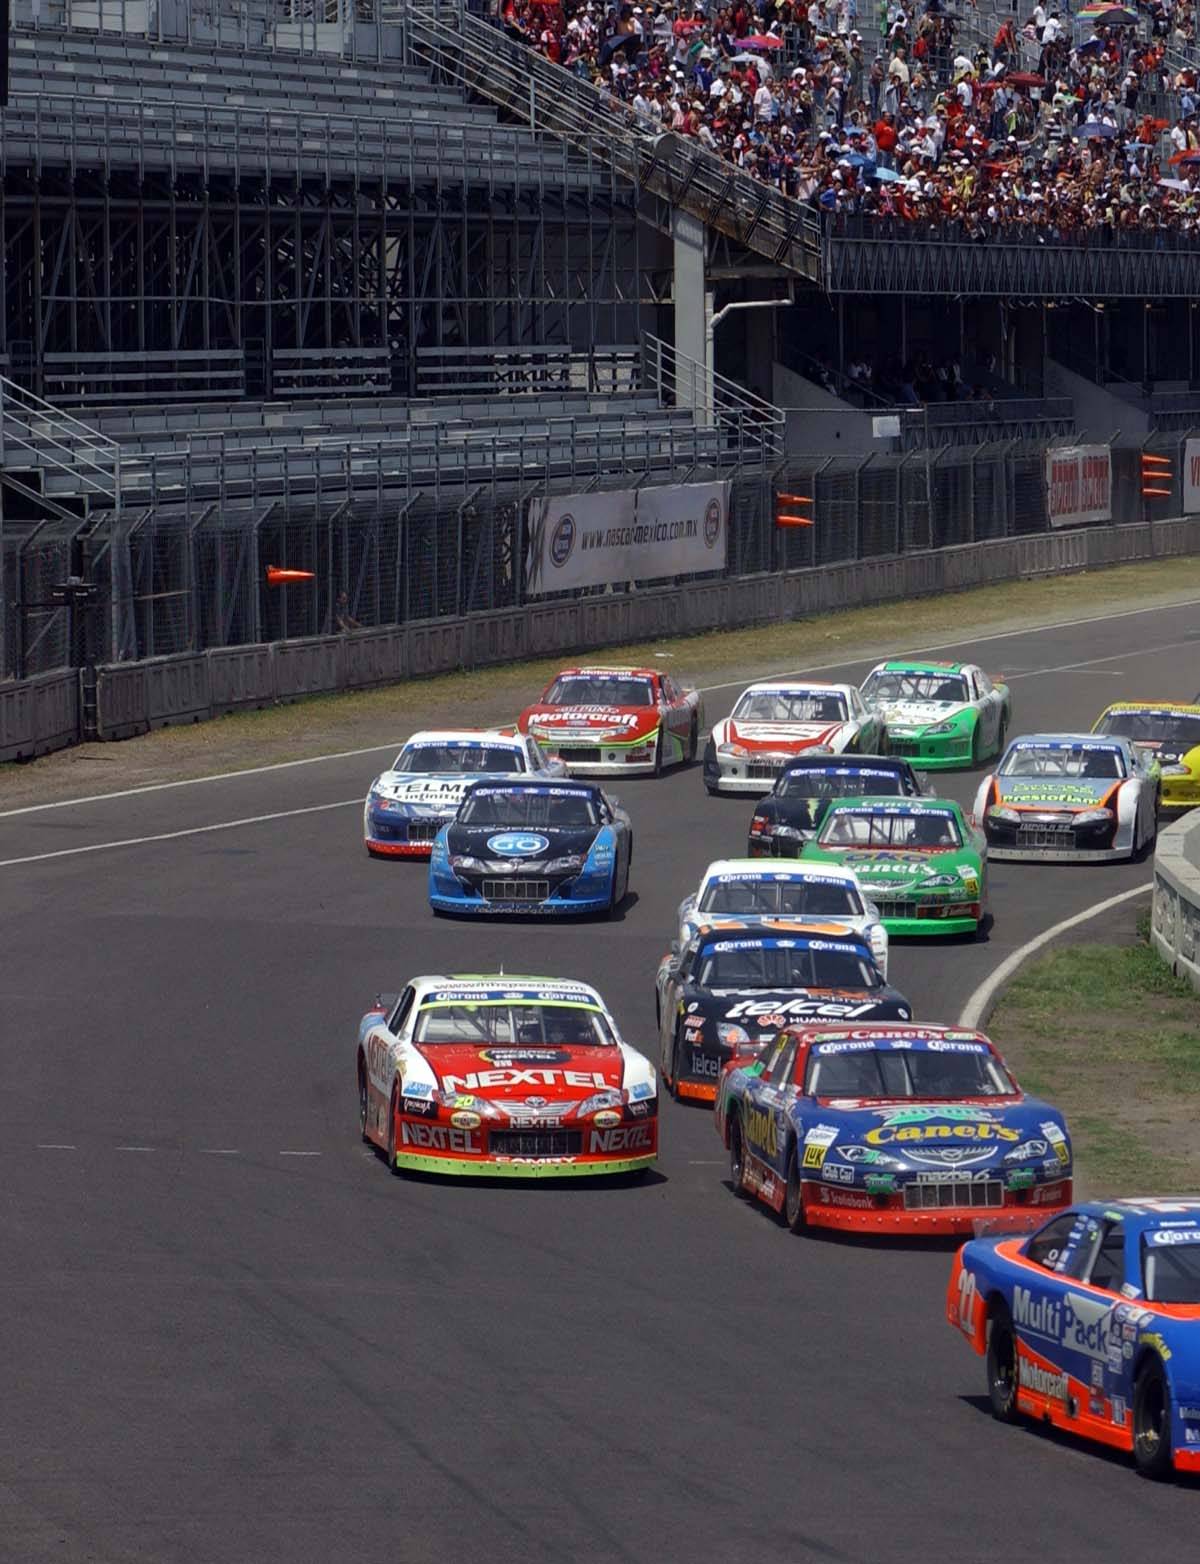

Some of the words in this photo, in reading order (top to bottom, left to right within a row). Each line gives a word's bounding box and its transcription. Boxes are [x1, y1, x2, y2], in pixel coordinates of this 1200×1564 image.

[529, 712, 638, 728] Motorcraft
[391, 783, 468, 794] TELM
[492, 840, 541, 851] GO
[718, 873, 762, 882] Corona
[803, 874, 846, 884] Corona
[714, 940, 762, 951] Corona
[808, 940, 857, 951] Corona
[436, 992, 488, 1001] Corona
[538, 992, 590, 1003] Corona
[725, 999, 876, 1018] telcel
[789, 1016, 844, 1024] HUAW
[851, 1030, 943, 1040] Canel's
[819, 1040, 875, 1054] Corona
[927, 1040, 983, 1052] Corona
[442, 1069, 620, 1094] NEXTEL
[454, 1095, 474, 1108] 20
[509, 1117, 563, 1129] NEXTEL
[401, 1121, 482, 1154] NEXTEL
[590, 1125, 651, 1153] NEXTEL
[865, 1123, 1020, 1145] Canel's
[1013, 1285, 1061, 1336] Multi
